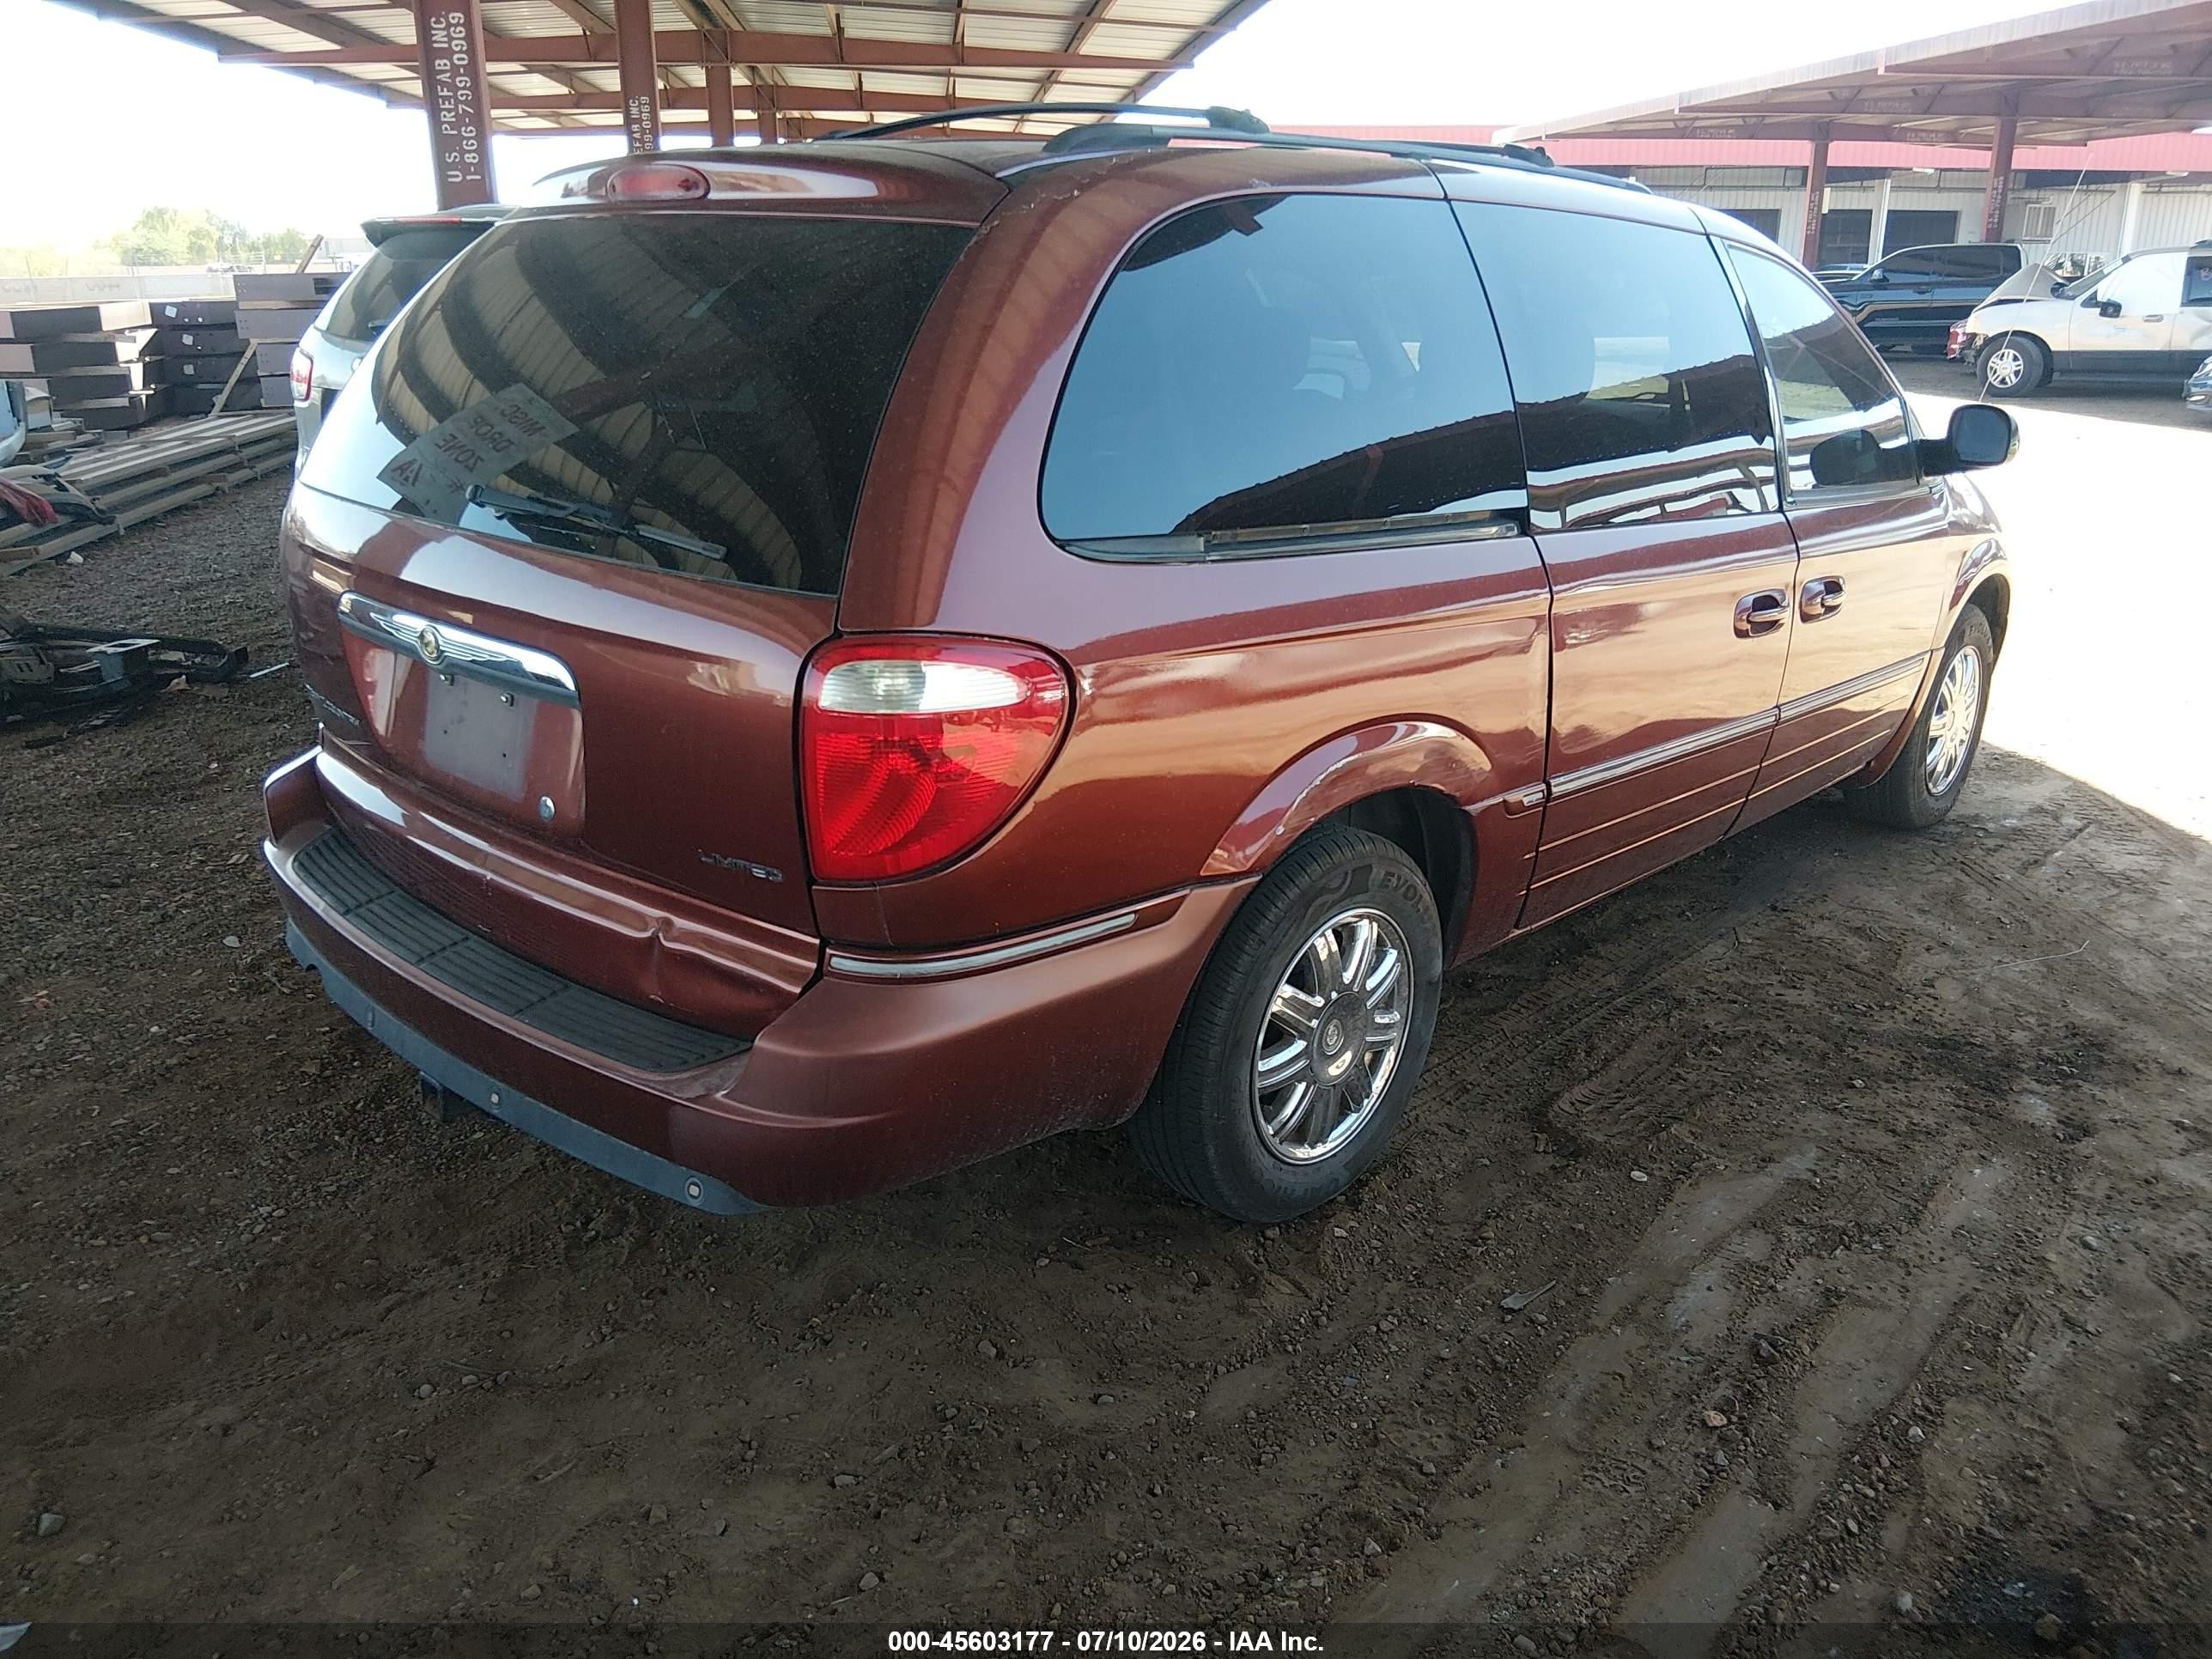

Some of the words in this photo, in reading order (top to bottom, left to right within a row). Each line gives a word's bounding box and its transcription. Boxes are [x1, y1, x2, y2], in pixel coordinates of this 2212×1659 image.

[430, 10, 449, 48] INC.
[434, 58, 459, 135] PREFAB
[448, 12, 482, 180] 1-866-799-0969
[629, 95, 641, 118] INC.
[446, 145, 463, 182] U.S.
